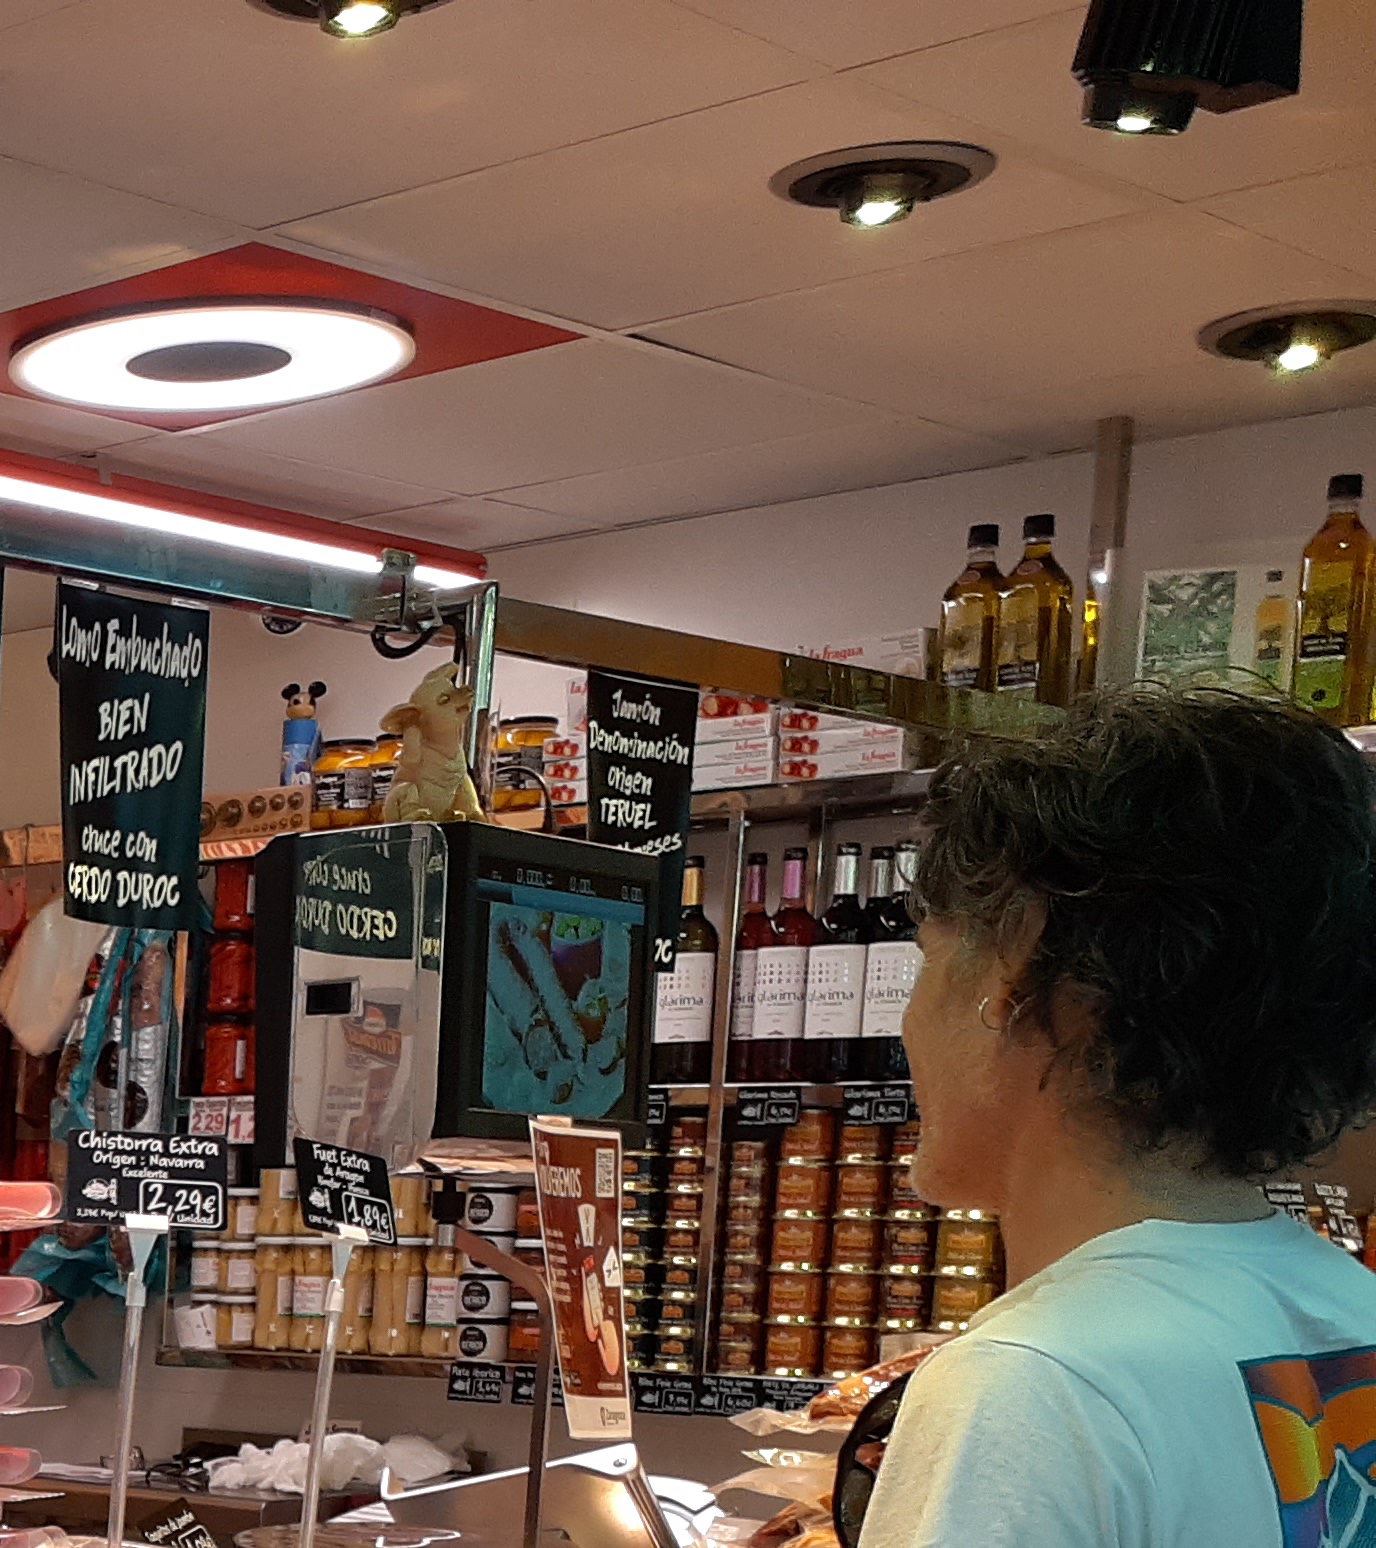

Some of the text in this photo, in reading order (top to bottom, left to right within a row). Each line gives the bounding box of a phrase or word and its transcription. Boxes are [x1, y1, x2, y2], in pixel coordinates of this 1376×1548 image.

[61, 605, 203, 688] Lomo Embuchado
[98, 692, 151, 741] BIEN
[69, 740, 184, 806] INFILTRADO
[600, 796, 658, 831] TERUEL
[82, 823, 158, 863] cruce con
[68, 861, 181, 911] CERDO DUROC
[78, 1130, 220, 1156] Chistorra Extra
[312, 1143, 371, 1172] Fuet Extra
[147, 1183, 217, 1218] 2,29€
[348, 1195, 389, 1232] 1,89€
